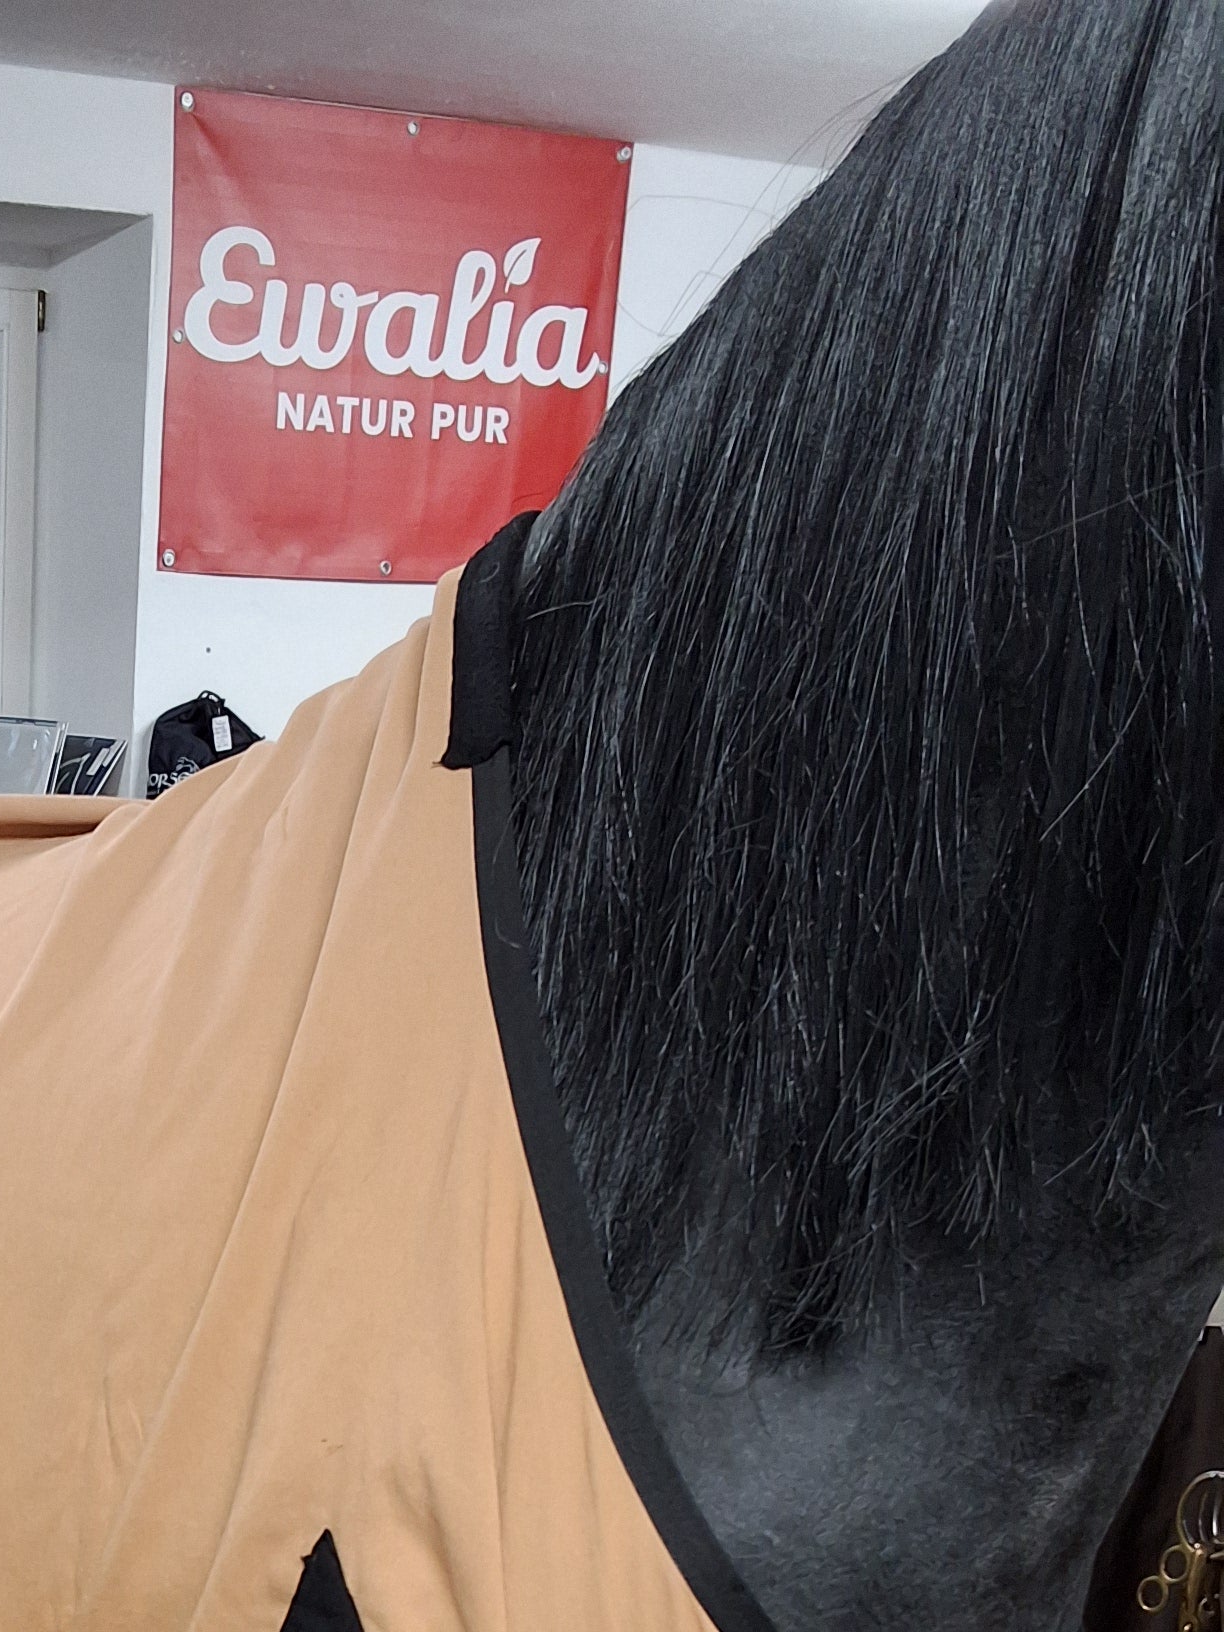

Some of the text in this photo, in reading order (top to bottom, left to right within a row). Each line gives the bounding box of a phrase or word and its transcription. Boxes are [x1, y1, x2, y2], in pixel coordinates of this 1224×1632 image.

[184, 226, 601, 388] Ewalia
[277, 392, 510, 444] NATUR PUR
